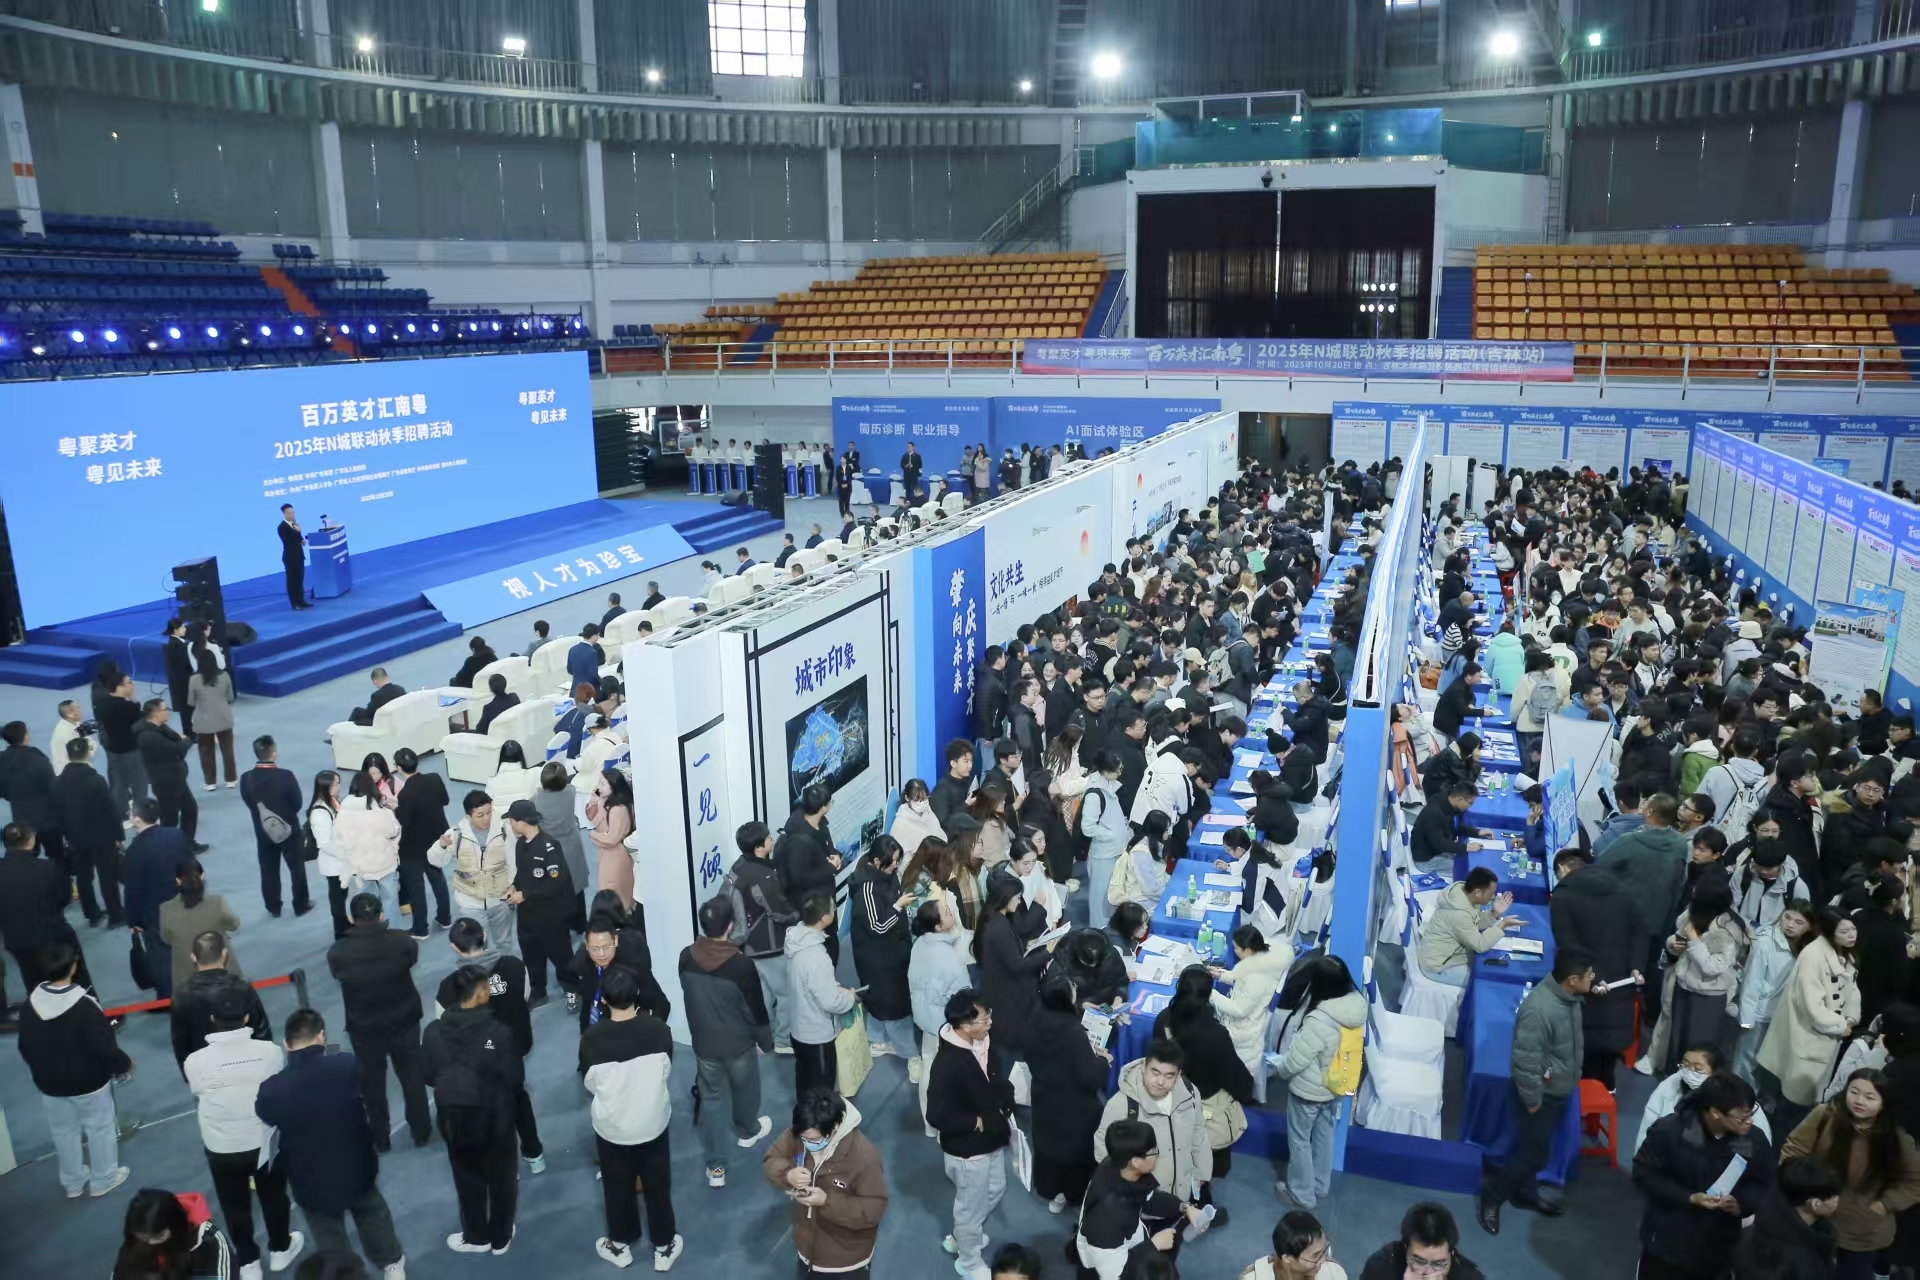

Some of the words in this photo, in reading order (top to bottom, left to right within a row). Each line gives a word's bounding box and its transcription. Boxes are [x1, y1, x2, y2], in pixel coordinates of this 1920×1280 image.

[1037, 348, 1080, 360] 粤聚英才
[1084, 348, 1133, 360] 粤见未来
[1145, 342, 1245, 366] 百万英才汇南粤
[301, 393, 428, 428] 百万英才汇南粤
[519, 389, 556, 405] 粤聚英才
[531, 408, 568, 425] 粤见未来
[859, 423, 905, 436] 简历诊断
[912, 423, 960, 436] 职业指导
[58, 430, 137, 457] 粤聚英才
[274, 420, 454, 459] 2025年N城联动秋季招聘活动
[1066, 424, 1145, 438] AI面试体验区
[86, 457, 163, 484] 粤见未来
[502, 544, 645, 600] 视人才为珍宝
[990, 559, 1025, 601] 文化共生
[795, 642, 857, 698] 城市印象
